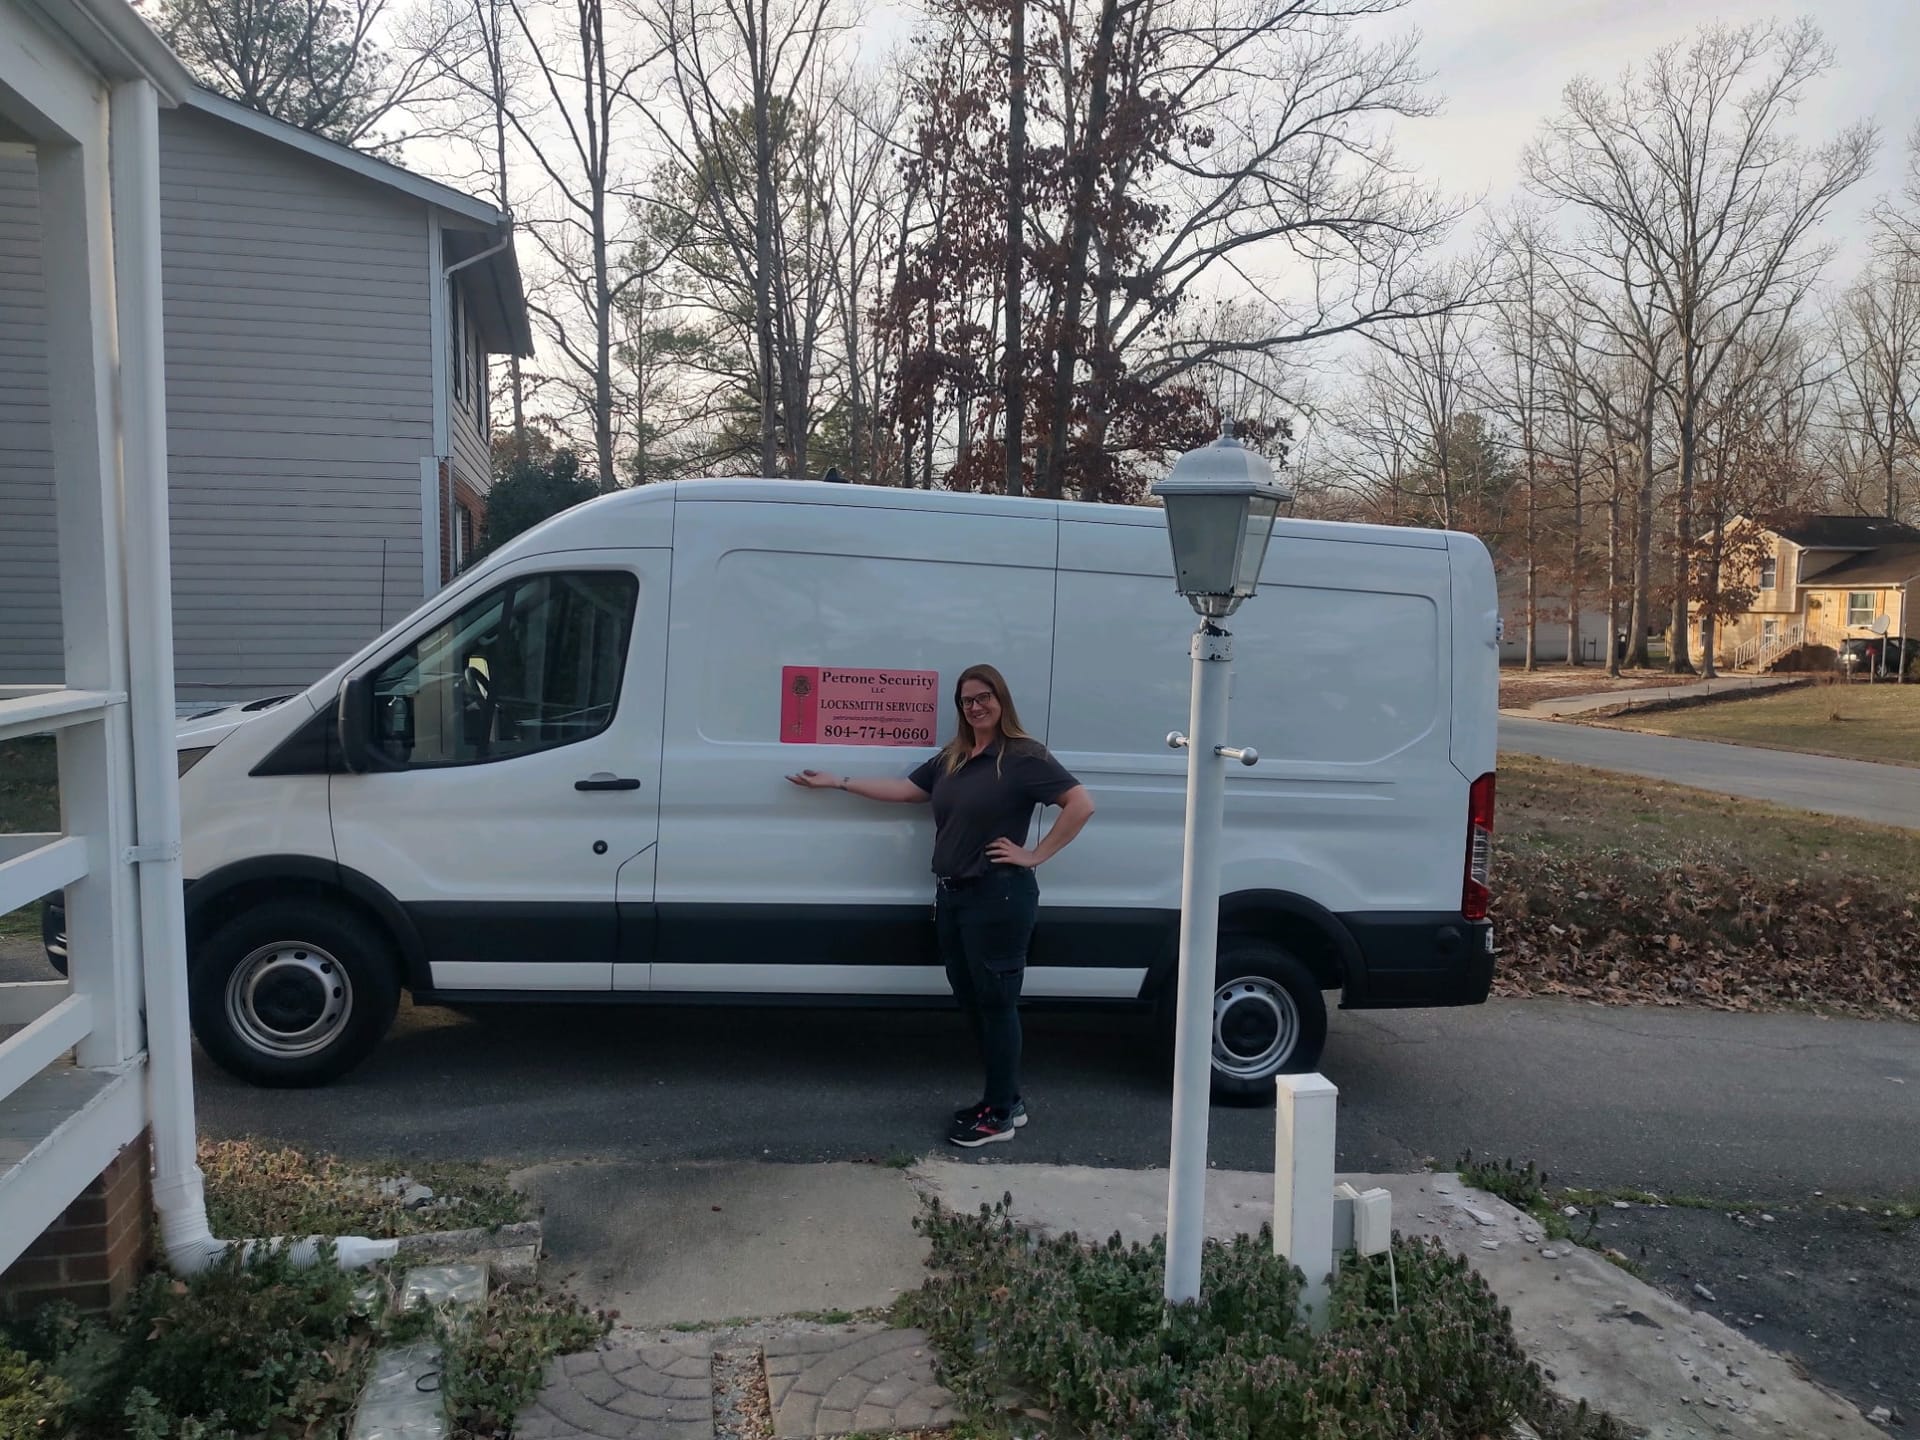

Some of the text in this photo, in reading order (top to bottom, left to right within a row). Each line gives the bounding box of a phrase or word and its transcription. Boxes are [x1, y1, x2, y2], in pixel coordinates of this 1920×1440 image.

[822, 671, 935, 689] Petrone Security
[820, 699, 935, 712] LOCKSMITH SERVICES
[824, 725, 929, 740] 804-774-0660
